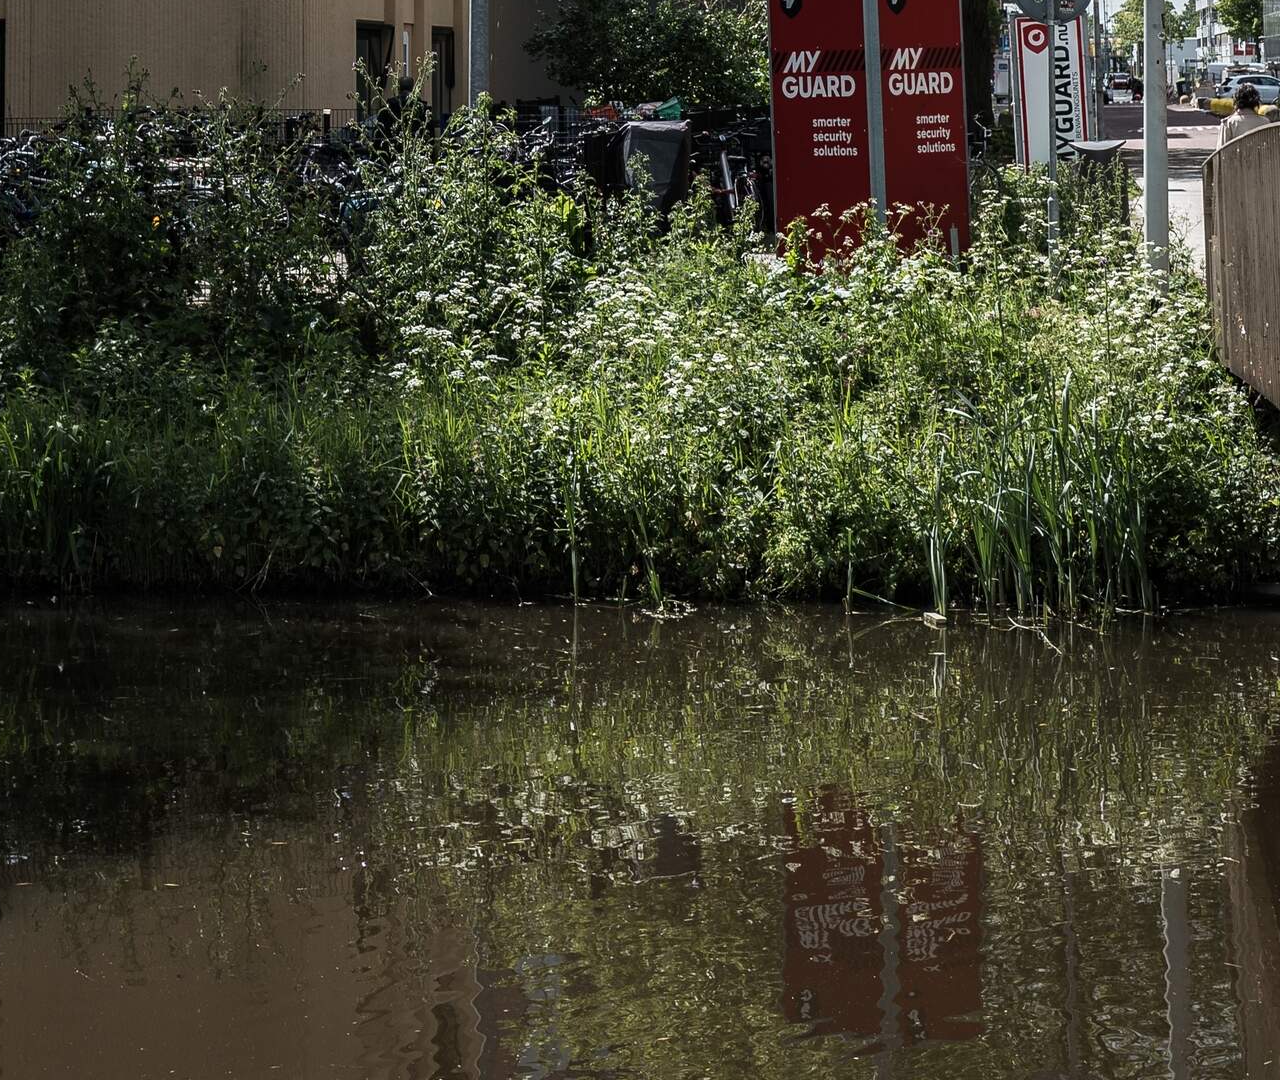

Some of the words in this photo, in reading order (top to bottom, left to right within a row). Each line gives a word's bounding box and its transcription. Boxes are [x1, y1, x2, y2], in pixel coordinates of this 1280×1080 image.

[783, 50, 821, 73] MY
[889, 47, 923, 70] MY
[782, 75, 856, 99] GUARD
[888, 71, 954, 96] GUARD
[1072, 71, 1082, 139] BEWAKINGSUNITS
[812, 117, 851, 127] smarter
[916, 113, 950, 124] smarter
[813, 130, 852, 143] security
[916, 127, 951, 140] security
[813, 144, 858, 157] solutions
[917, 141, 956, 153] solutions
